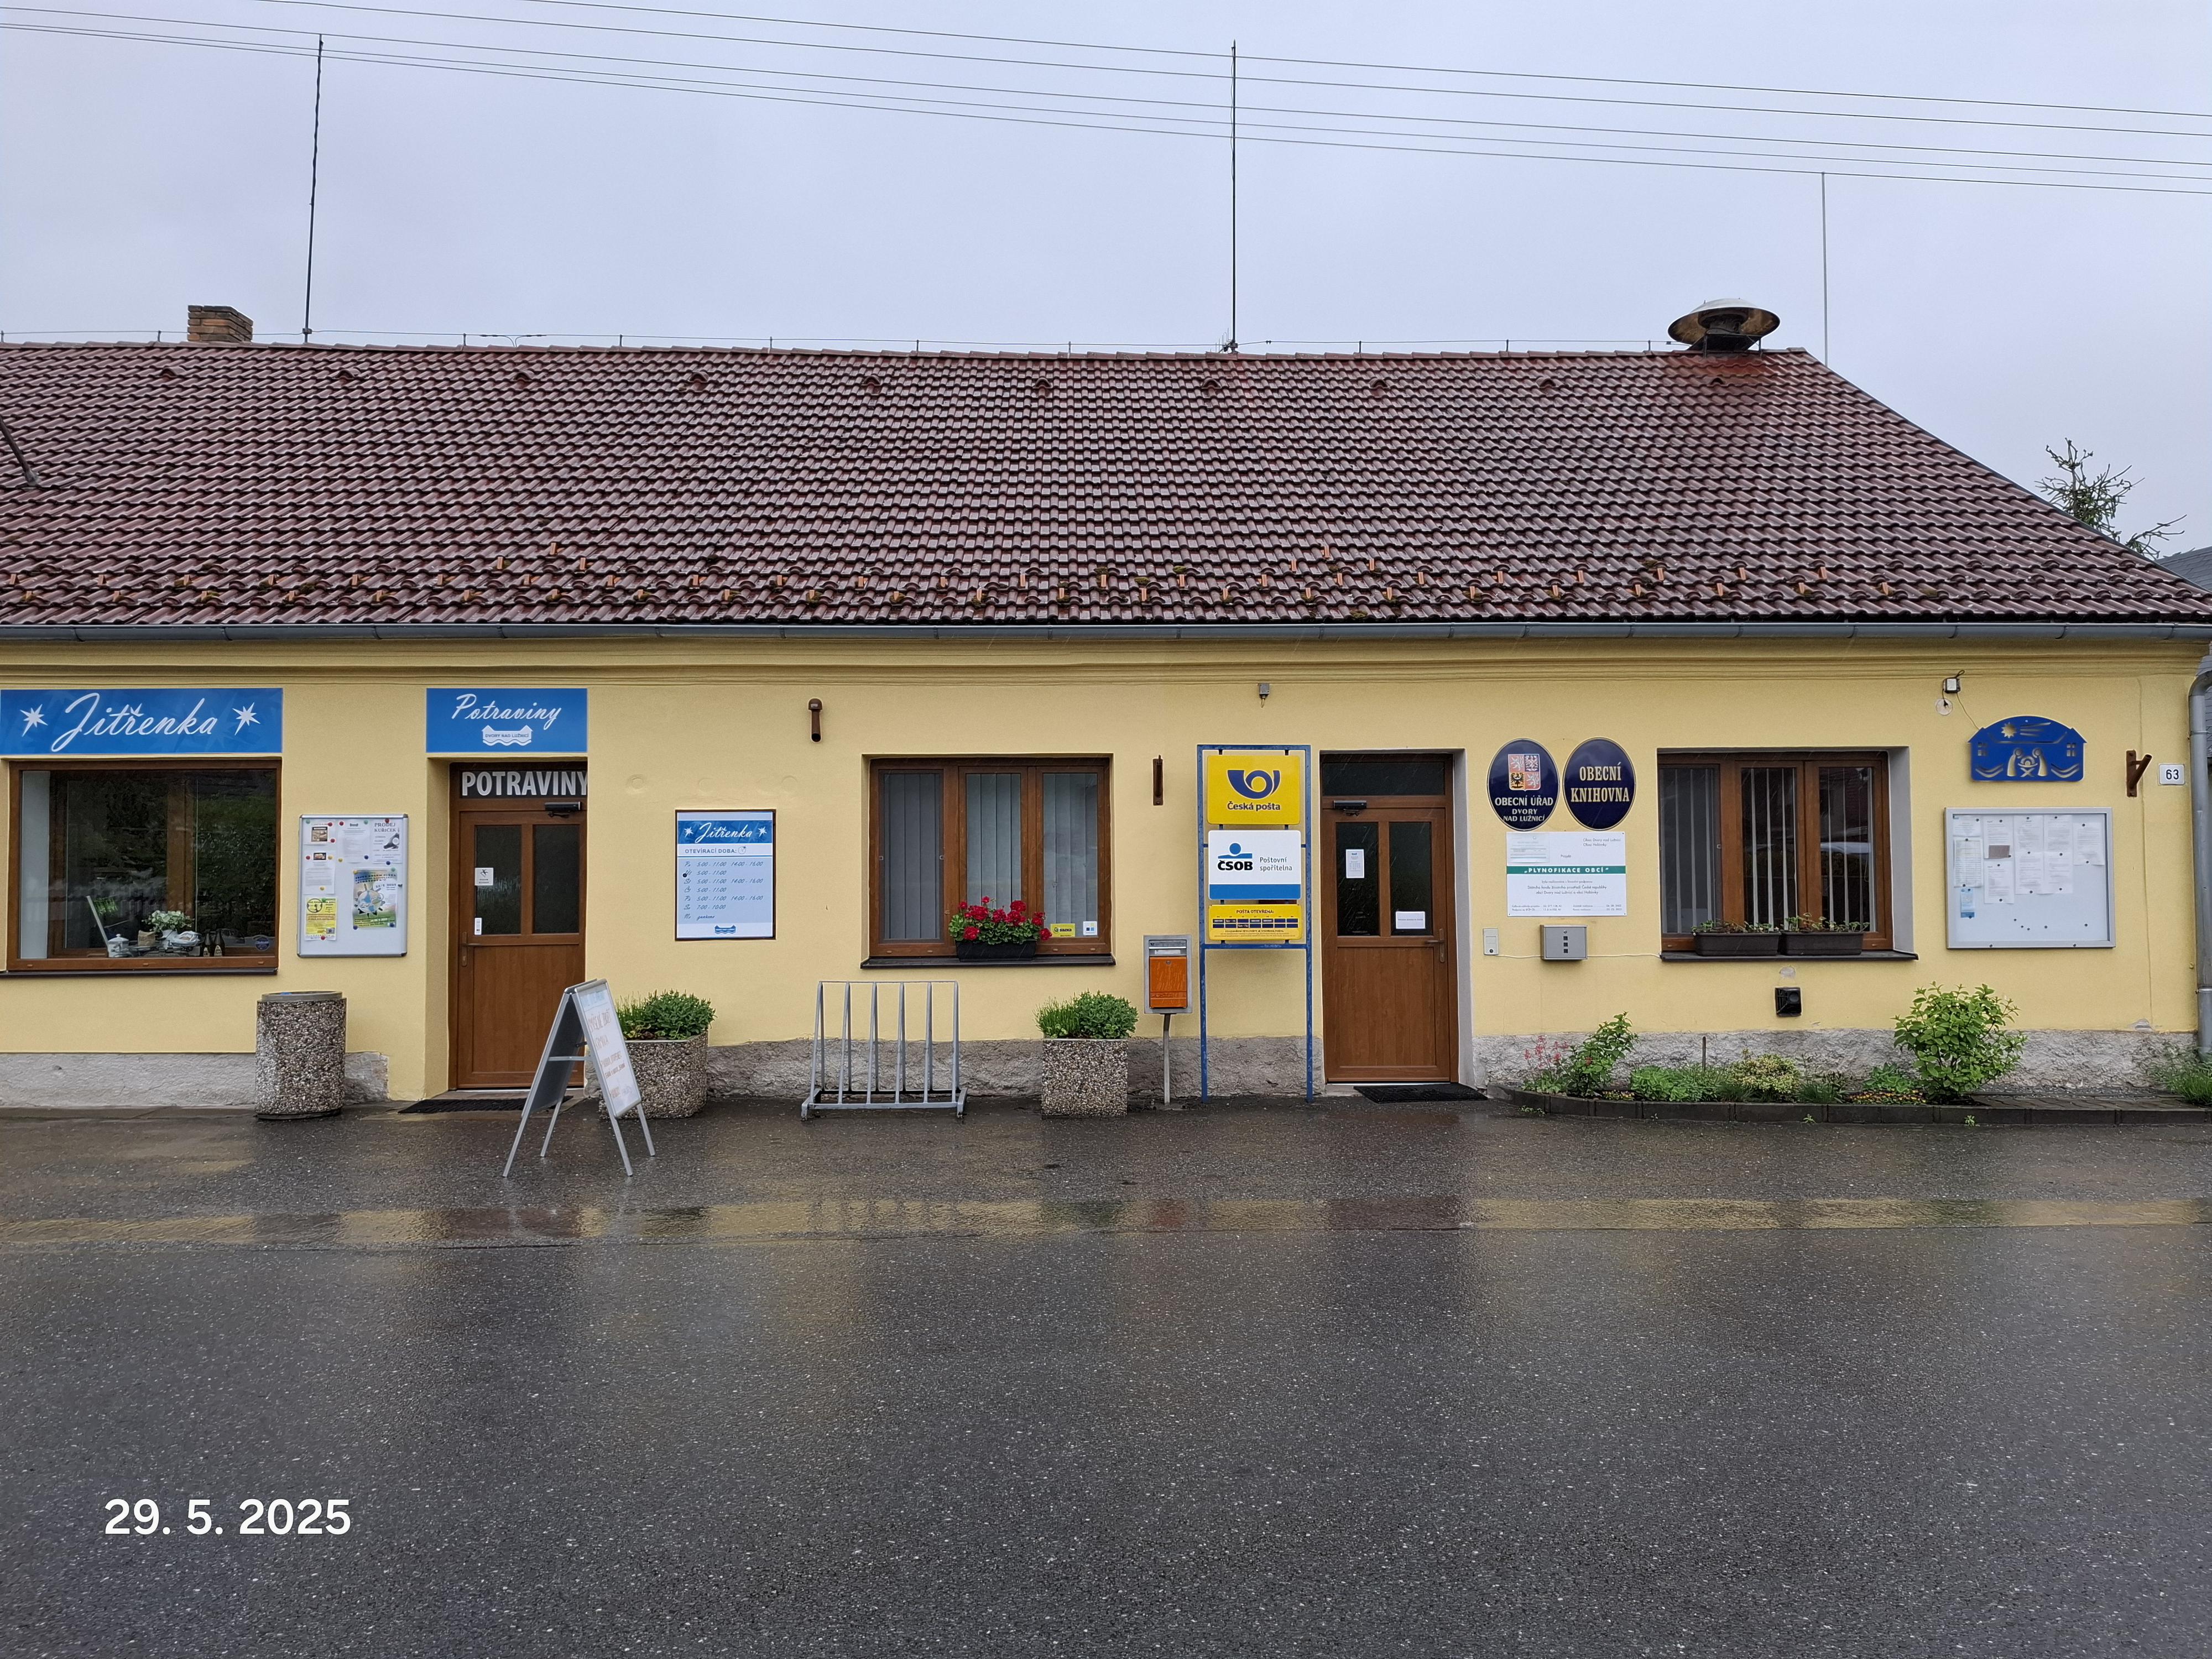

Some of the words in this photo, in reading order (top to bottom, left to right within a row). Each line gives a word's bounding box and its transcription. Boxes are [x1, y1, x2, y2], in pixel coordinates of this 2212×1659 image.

[451, 693, 562, 731] Potraviny
[51, 692, 218, 752] Jitřenka
[1579, 761, 1621, 781] OBECNÍ
[2166, 769, 2179, 780] 63
[462, 771, 588, 796] POTRAVINY
[1495, 795, 1528, 806] OBECNÍ
[1530, 795, 1553, 806] ÚŘAD
[1571, 787, 1630, 802] KNIHOVNA
[1227, 801, 1254, 810] Česká
[1255, 802, 1281, 811] pošta
[695, 822, 753, 843] Jitřenka
[1217, 860, 1253, 871] ČSOB
